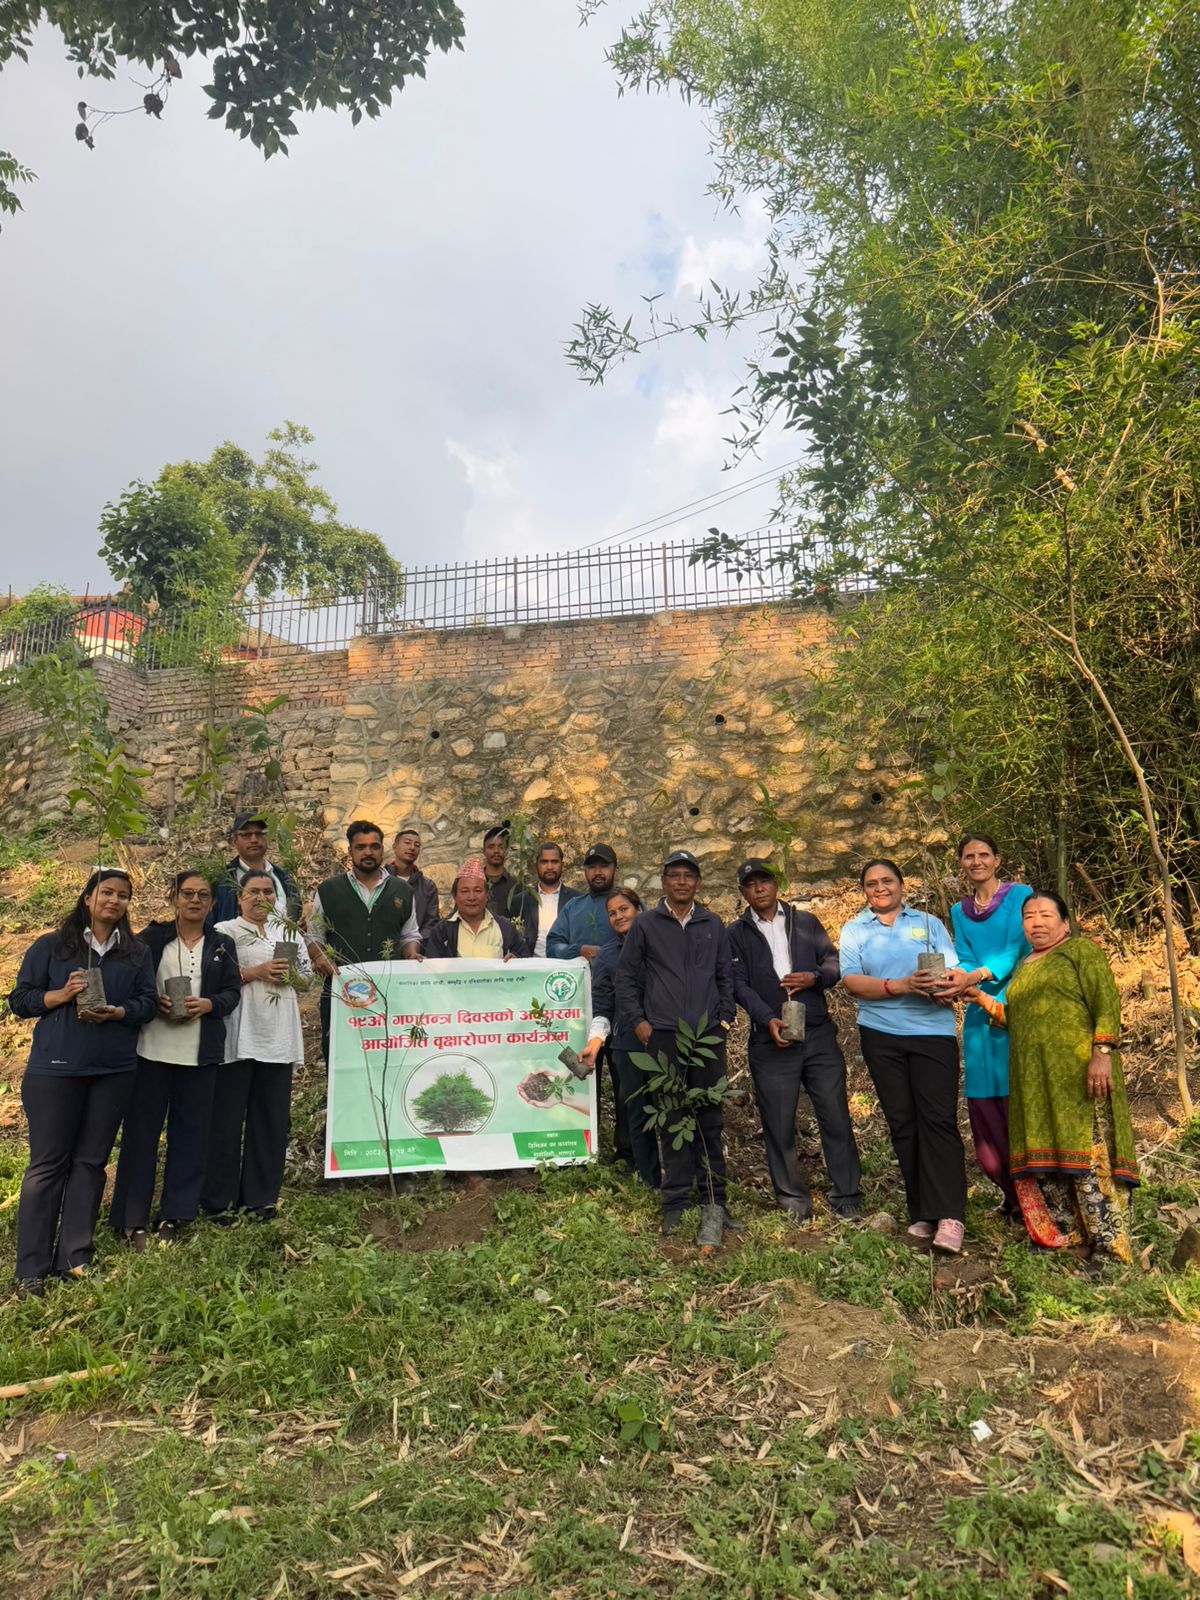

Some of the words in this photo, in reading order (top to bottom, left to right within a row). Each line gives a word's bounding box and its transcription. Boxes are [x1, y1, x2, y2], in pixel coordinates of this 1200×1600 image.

[392, 1013, 451, 1026] गणतन्त्र
[457, 1008, 513, 1024] दिवसको
[433, 1031, 501, 1050] वृक्षारोपण
[506, 1029, 569, 1044] कार्यक्रम
